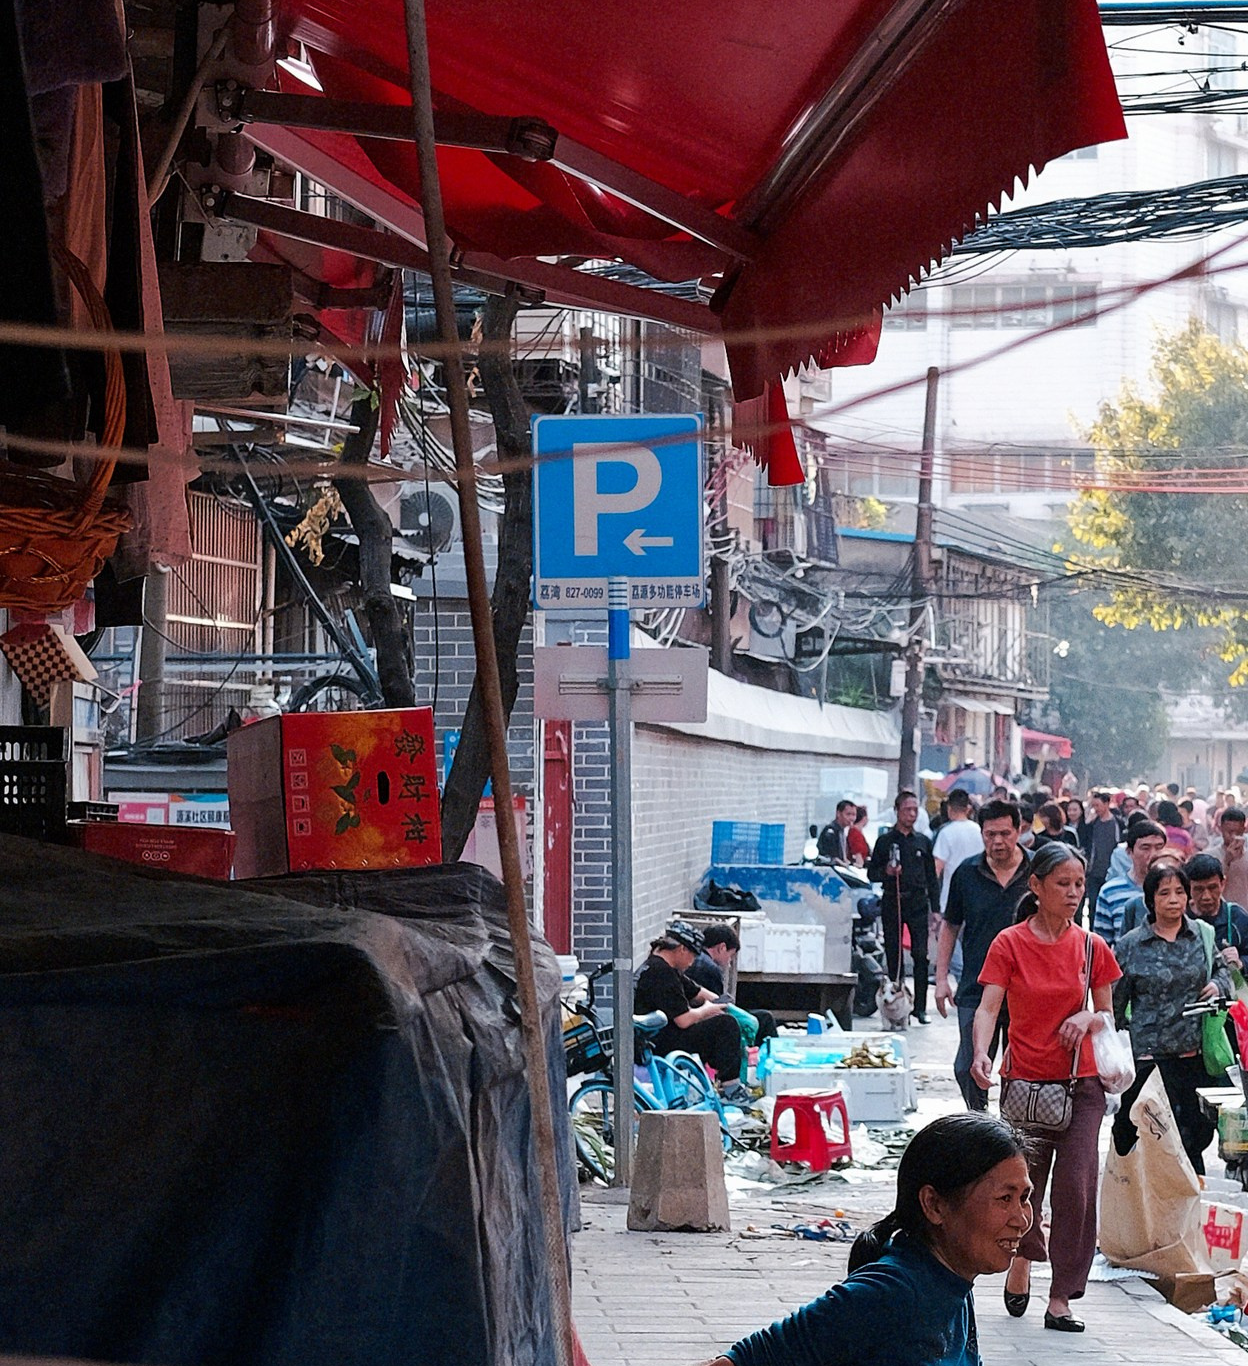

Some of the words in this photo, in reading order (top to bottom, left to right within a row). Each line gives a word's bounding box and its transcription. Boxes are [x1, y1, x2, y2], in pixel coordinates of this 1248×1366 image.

[573, 442, 662, 556] P
[540, 585, 561, 600] 荔湾
[565, 586, 604, 599] 827-0099
